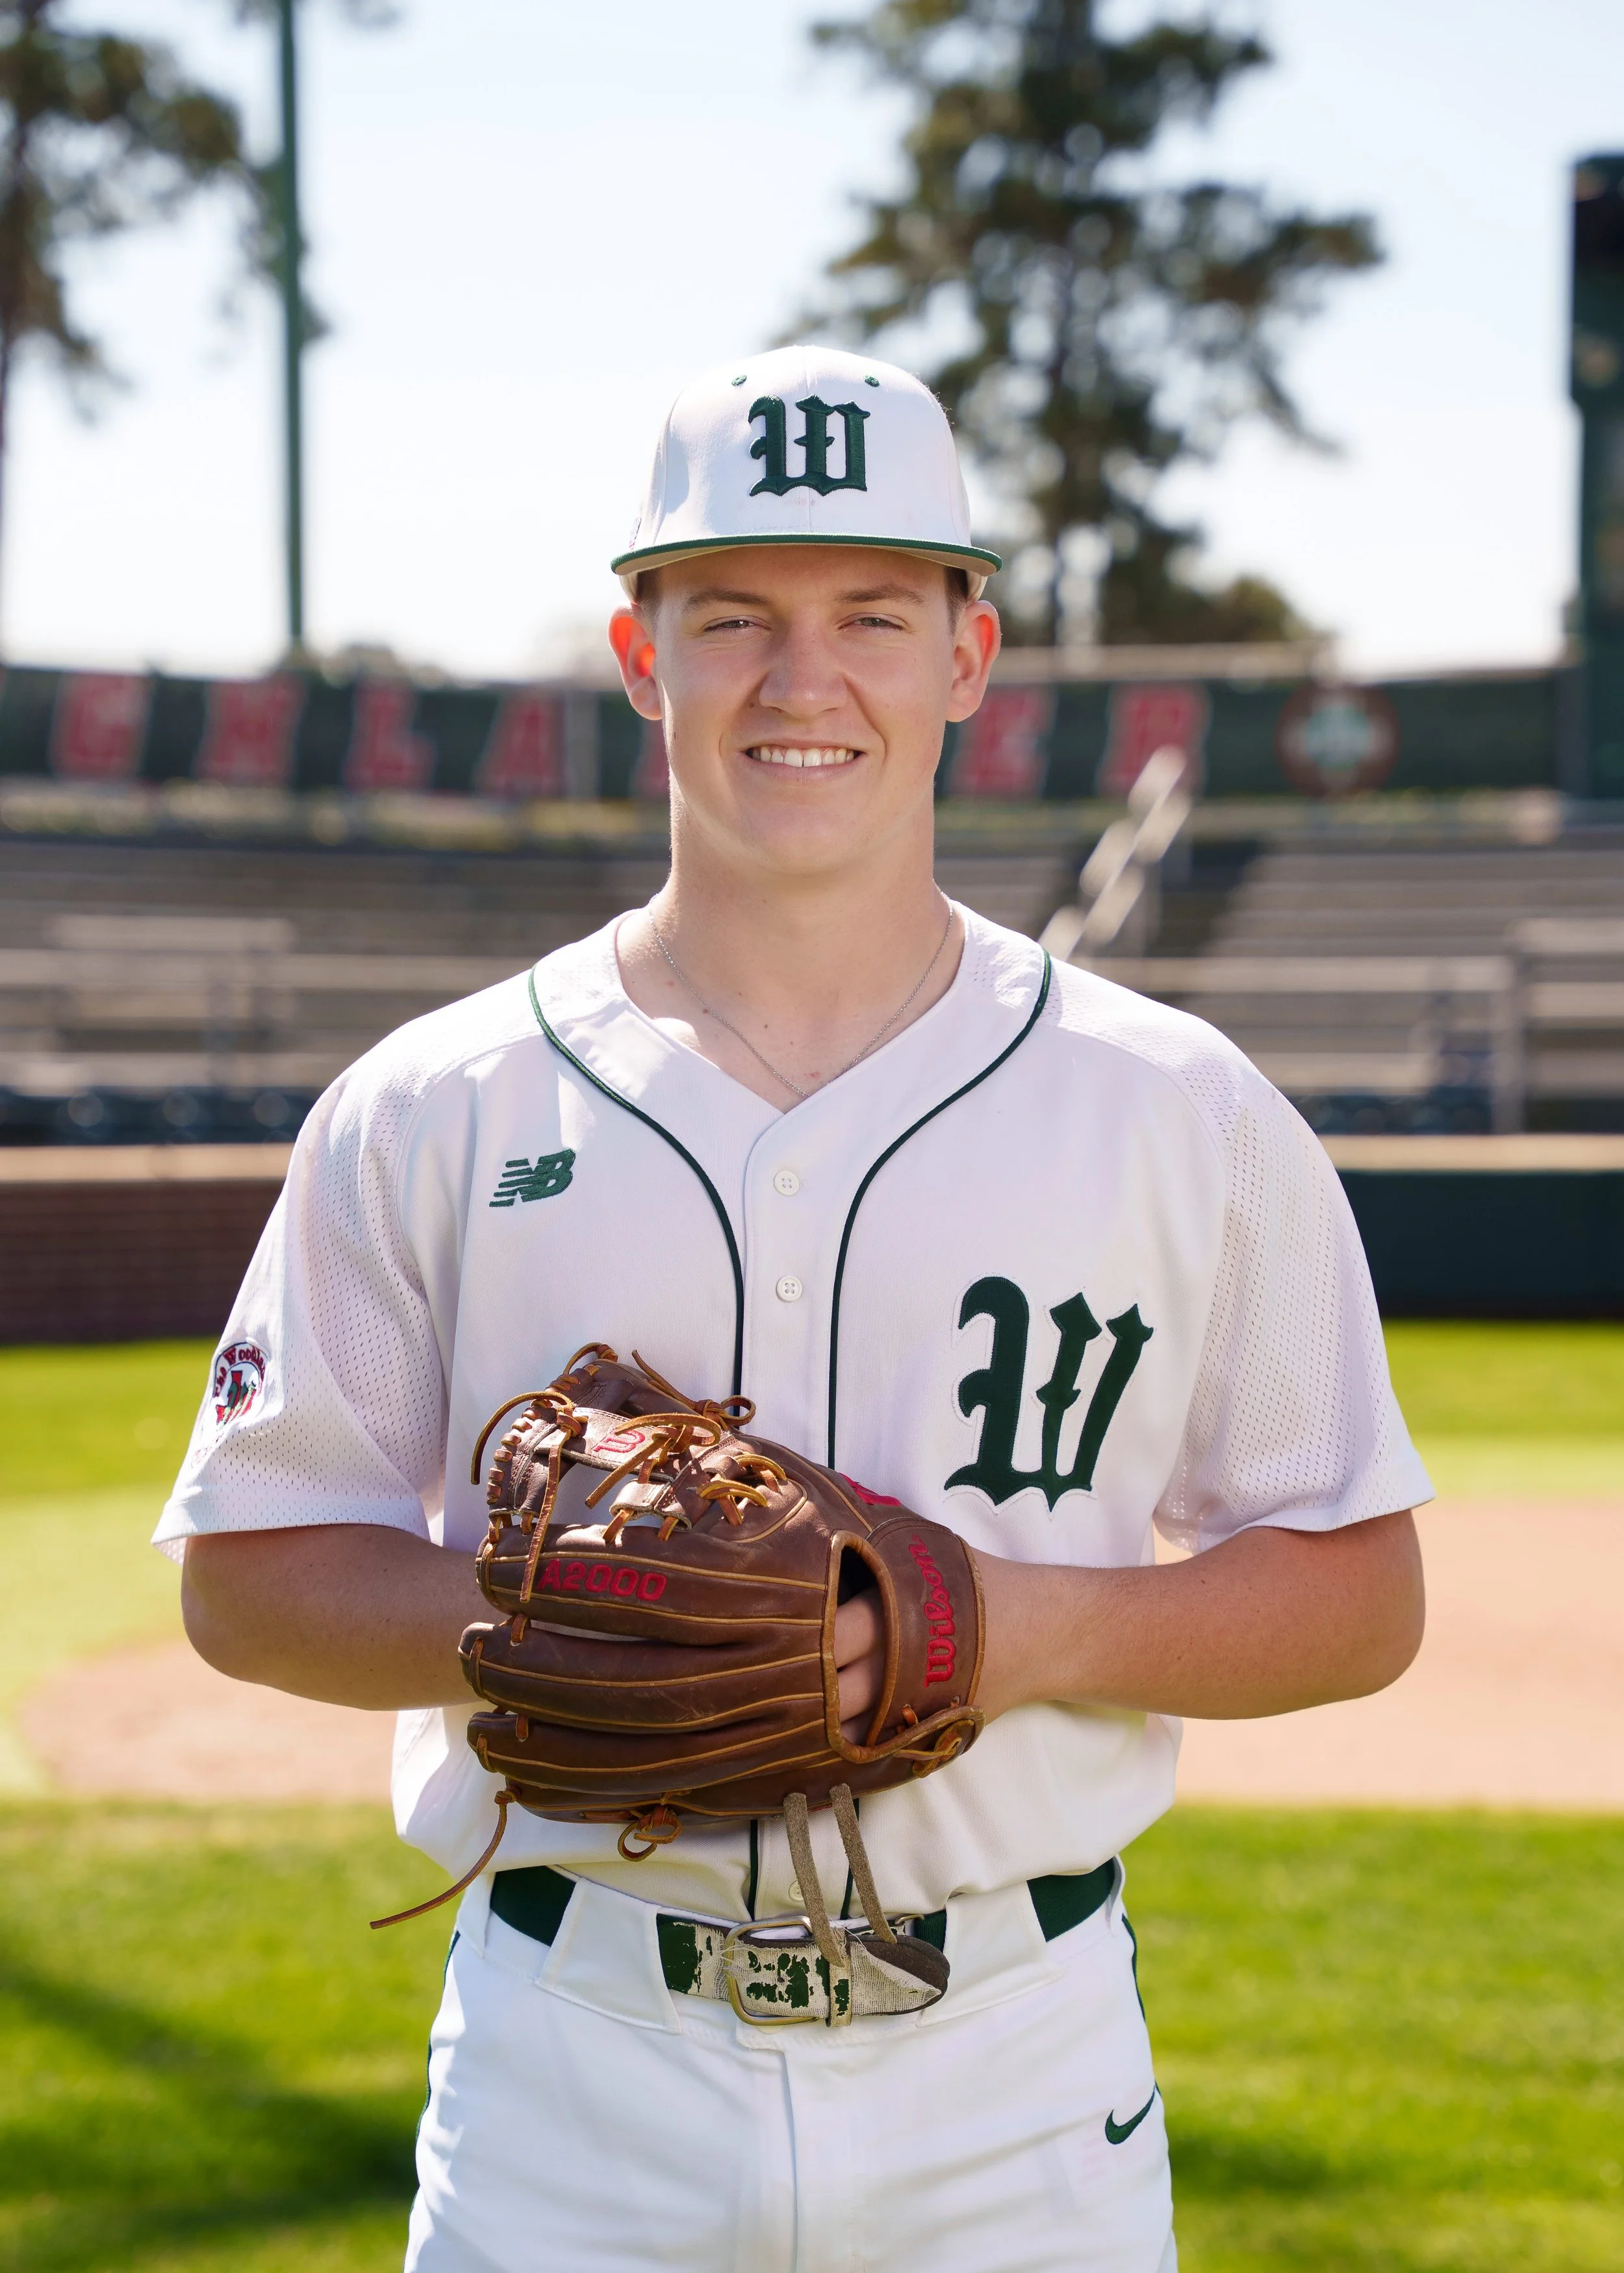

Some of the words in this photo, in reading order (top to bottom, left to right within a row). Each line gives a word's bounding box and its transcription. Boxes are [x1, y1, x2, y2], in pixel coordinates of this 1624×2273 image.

[748, 394, 870, 496] W
[943, 1275, 1154, 1514] W
[538, 1558, 666, 1602] A2000
[909, 1534, 956, 1688] Wilson
